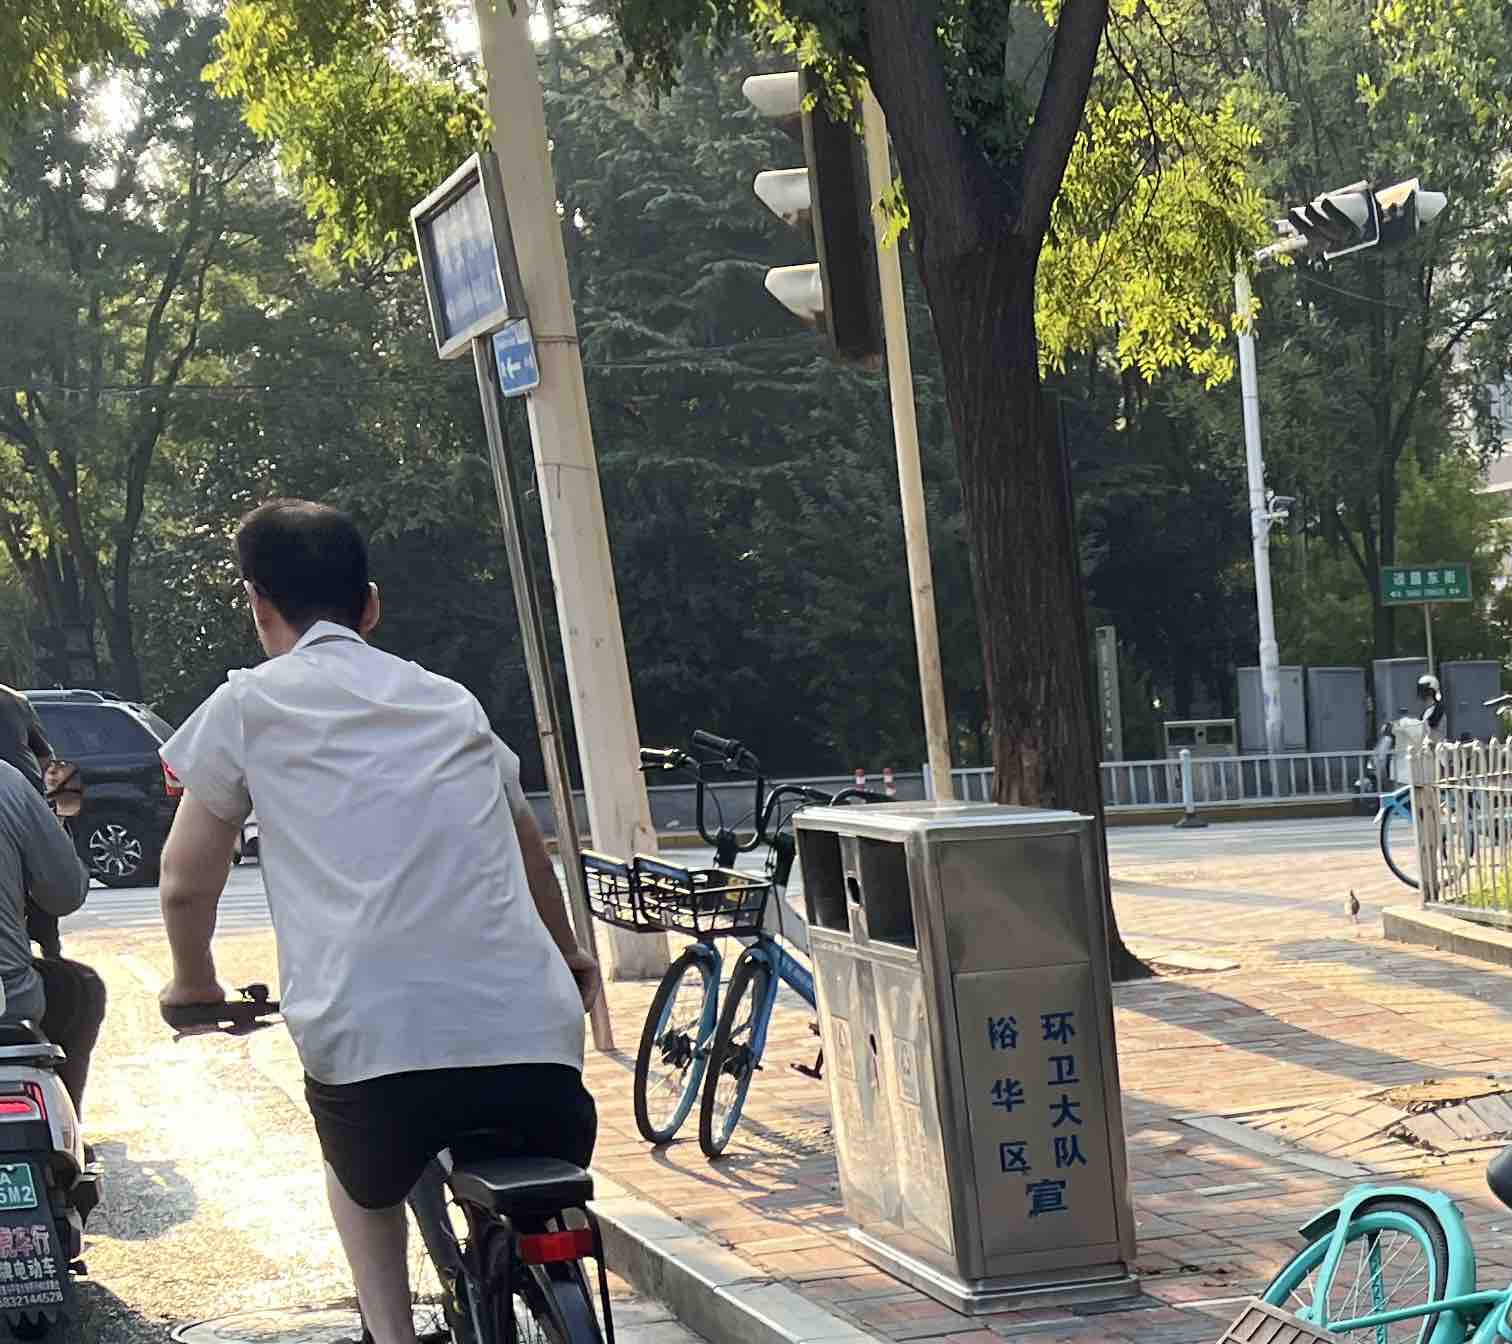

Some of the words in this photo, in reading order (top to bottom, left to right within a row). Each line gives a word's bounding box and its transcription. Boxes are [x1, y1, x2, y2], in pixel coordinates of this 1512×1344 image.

[986, 1015, 1031, 1175] 裕华区
[1040, 1010, 1088, 1169] 环卫大队
[1025, 1178, 1069, 1218] 宣
